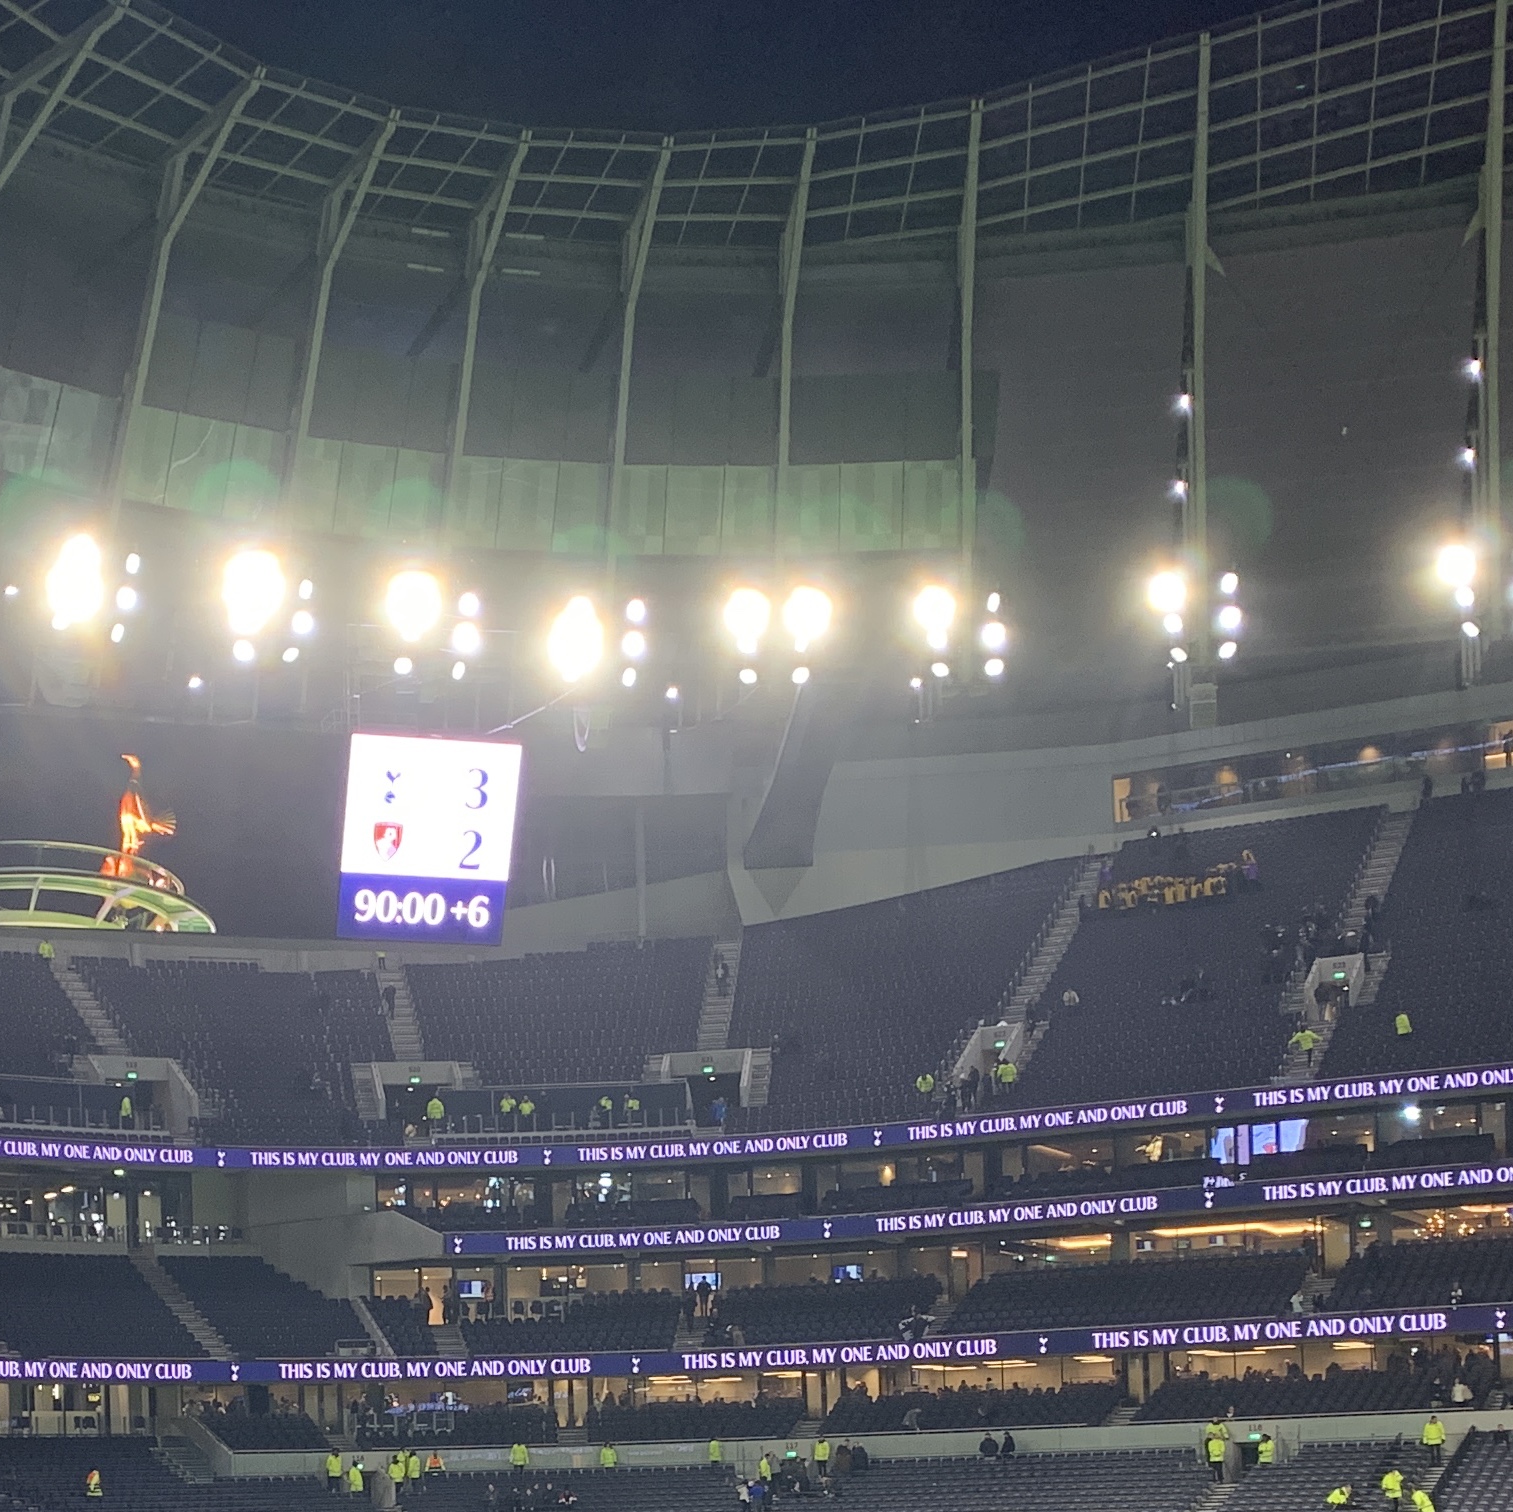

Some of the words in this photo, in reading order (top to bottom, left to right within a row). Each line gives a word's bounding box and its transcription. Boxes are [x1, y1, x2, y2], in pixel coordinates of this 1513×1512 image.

[465, 768, 490, 810] 3
[458, 830, 483, 870] 2
[354, 889, 445, 926] 90:00
[449, 894, 490, 928] +6
[1253, 1089, 1287, 1107] THIS
[1290, 1088, 1305, 1104] IS
[1307, 1085, 1331, 1102] MY
[1379, 1078, 1404, 1095] MY
[1406, 1075, 1440, 1092] ONE
[1443, 1072, 1479, 1089] AND
[875, 1216, 907, 1232] THIS
[908, 1215, 922, 1230] IS
[924, 1213, 946, 1228] MY
[988, 1208, 1011, 1223] MY
[1013, 1205, 1044, 1221] ONE
[1046, 1202, 1078, 1219] AND
[1080, 1199, 1117, 1216] ONLY
[1119, 1195, 1158, 1213] CLUB
[1091, 1330, 1130, 1349] THIS
[1133, 1329, 1149, 1347] IS
[1152, 1328, 1179, 1346] MY
[1233, 1323, 1261, 1341] MY
[1265, 1320, 1303, 1339] ONE
[1306, 1318, 1346, 1337] AND
[1349, 1315, 1395, 1335] ONLY
[1399, 1313, 1447, 1332] CLUB
[24, 1361, 47, 1378] MY
[49, 1361, 78, 1379] ONE
[80, 1362, 113, 1379] AND
[115, 1362, 152, 1379] ONLY
[155, 1363, 192, 1380] CLUB
[278, 1362, 313, 1379] THIS
[316, 1362, 331, 1379] IS
[333, 1362, 358, 1379] MY
[406, 1361, 431, 1378] MY
[434, 1360, 468, 1377] ONE
[470, 1360, 505, 1376] AND
[507, 1359, 547, 1376] ONLY
[550, 1358, 591, 1375] CLUB
[681, 1353, 718, 1370] THIS
[720, 1352, 736, 1368] IS
[738, 1351, 763, 1367] MY
[812, 1347, 837, 1364] MY
[840, 1345, 873, 1363] ONE
[876, 1343, 910, 1361] AND
[912, 1341, 953, 1359] ONLY
[956, 1338, 997, 1357] CLUB
